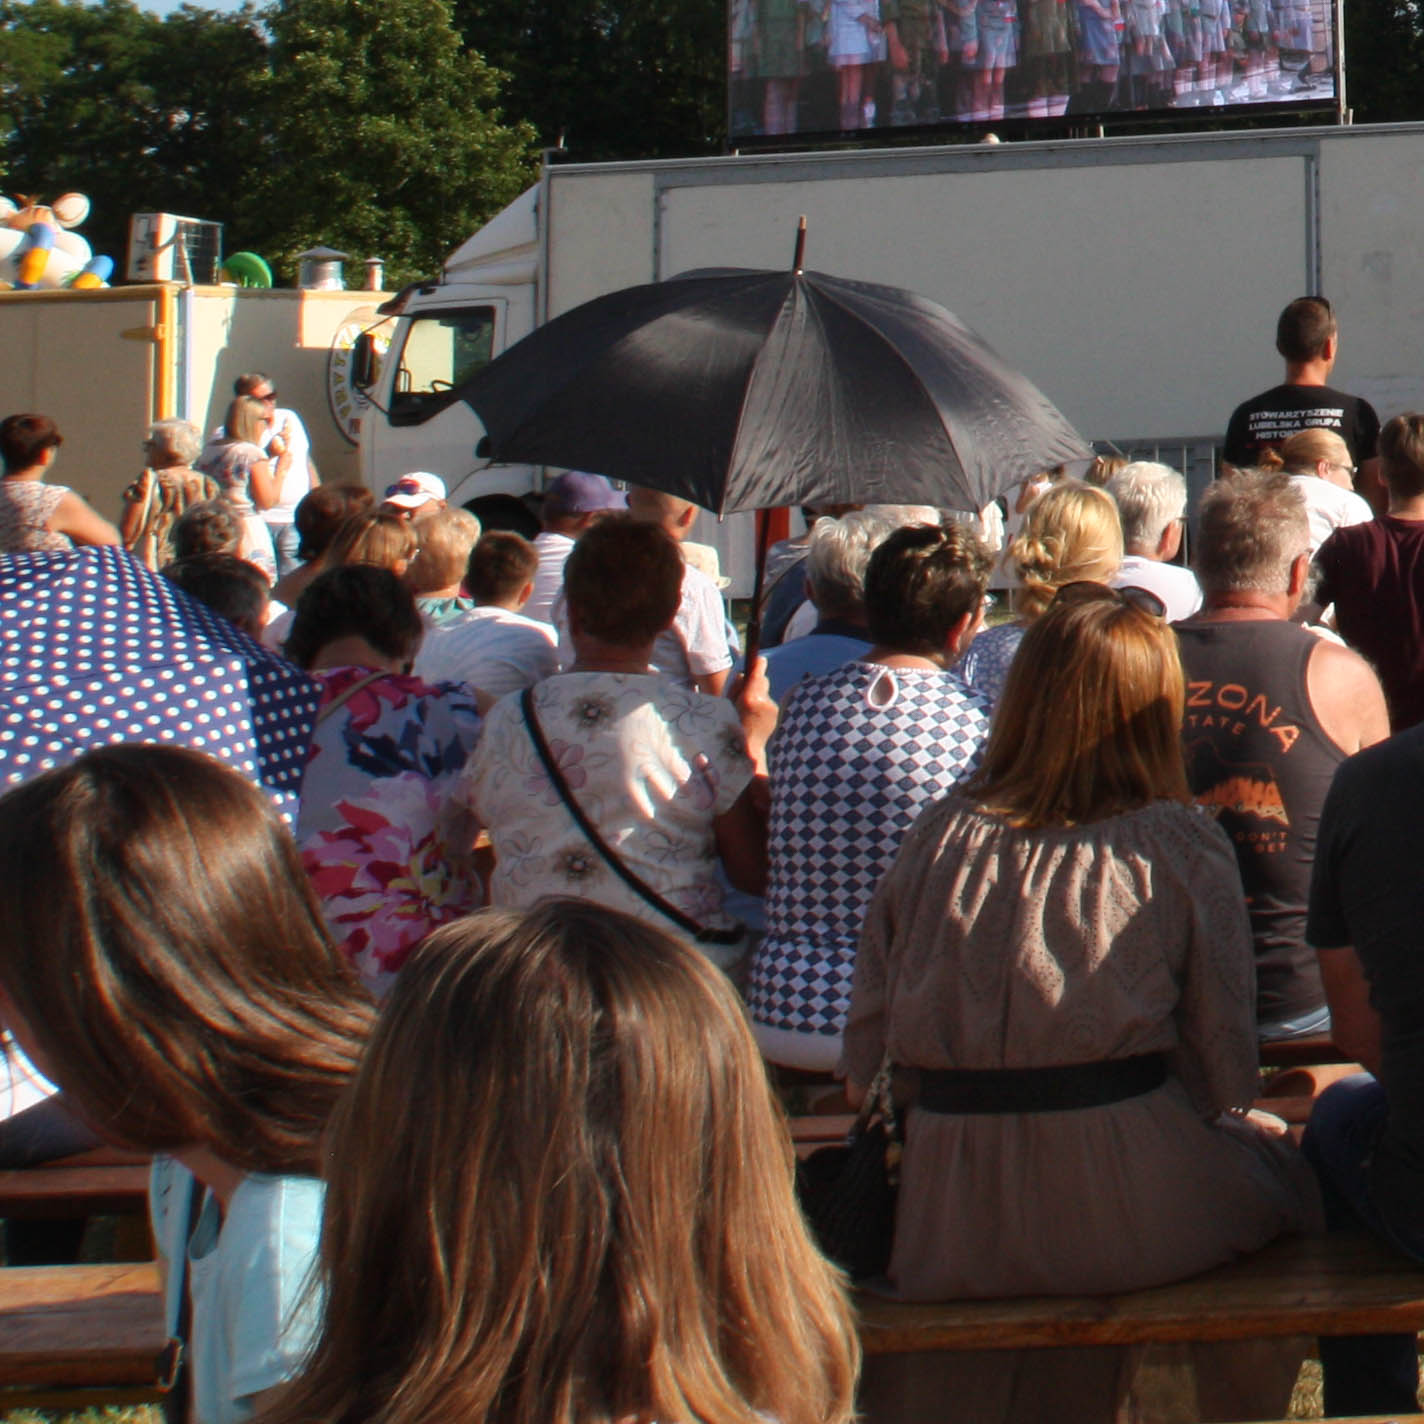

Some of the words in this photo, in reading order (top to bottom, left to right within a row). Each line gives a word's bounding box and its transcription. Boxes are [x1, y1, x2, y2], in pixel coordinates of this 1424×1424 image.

[1249, 408, 1345, 421] STOWARZYSZENIE
[1249, 420, 1301, 431] LUBELSKA
[1304, 417, 1342, 428] GRUPA
[1186, 681, 1300, 754] ZONA
[1187, 714, 1247, 736] TATE
